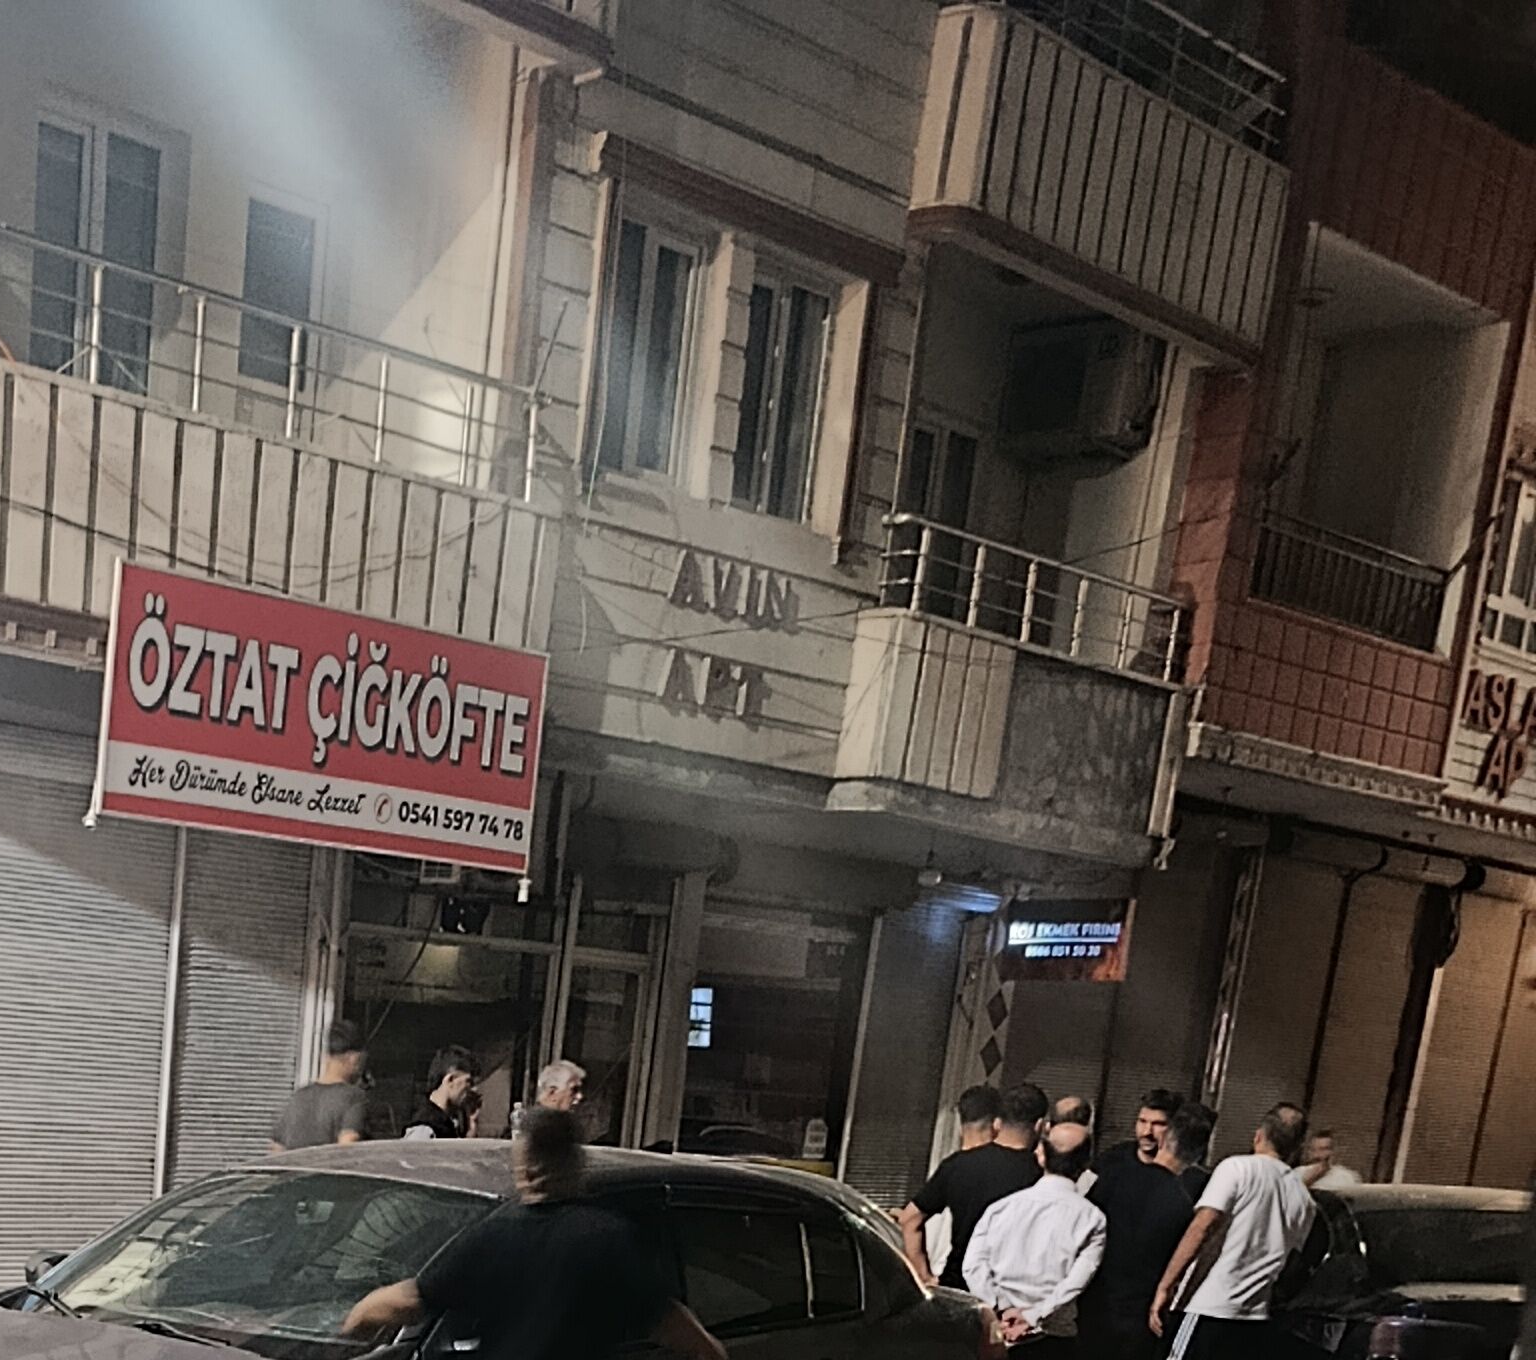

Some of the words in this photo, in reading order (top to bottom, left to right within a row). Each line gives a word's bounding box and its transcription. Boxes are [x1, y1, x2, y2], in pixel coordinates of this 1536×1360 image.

[129, 592, 301, 733] ÖZTAT
[308, 632, 530, 776] ÇİĞKÖFTE
[128, 755, 166, 788] Her
[170, 760, 247, 797] Dürümde
[307, 784, 367, 815] Lezzet
[399, 801, 439, 827] 0541
[443, 809, 474, 832] 597
[479, 814, 499, 836] 74
[504, 819, 524, 841] 78
